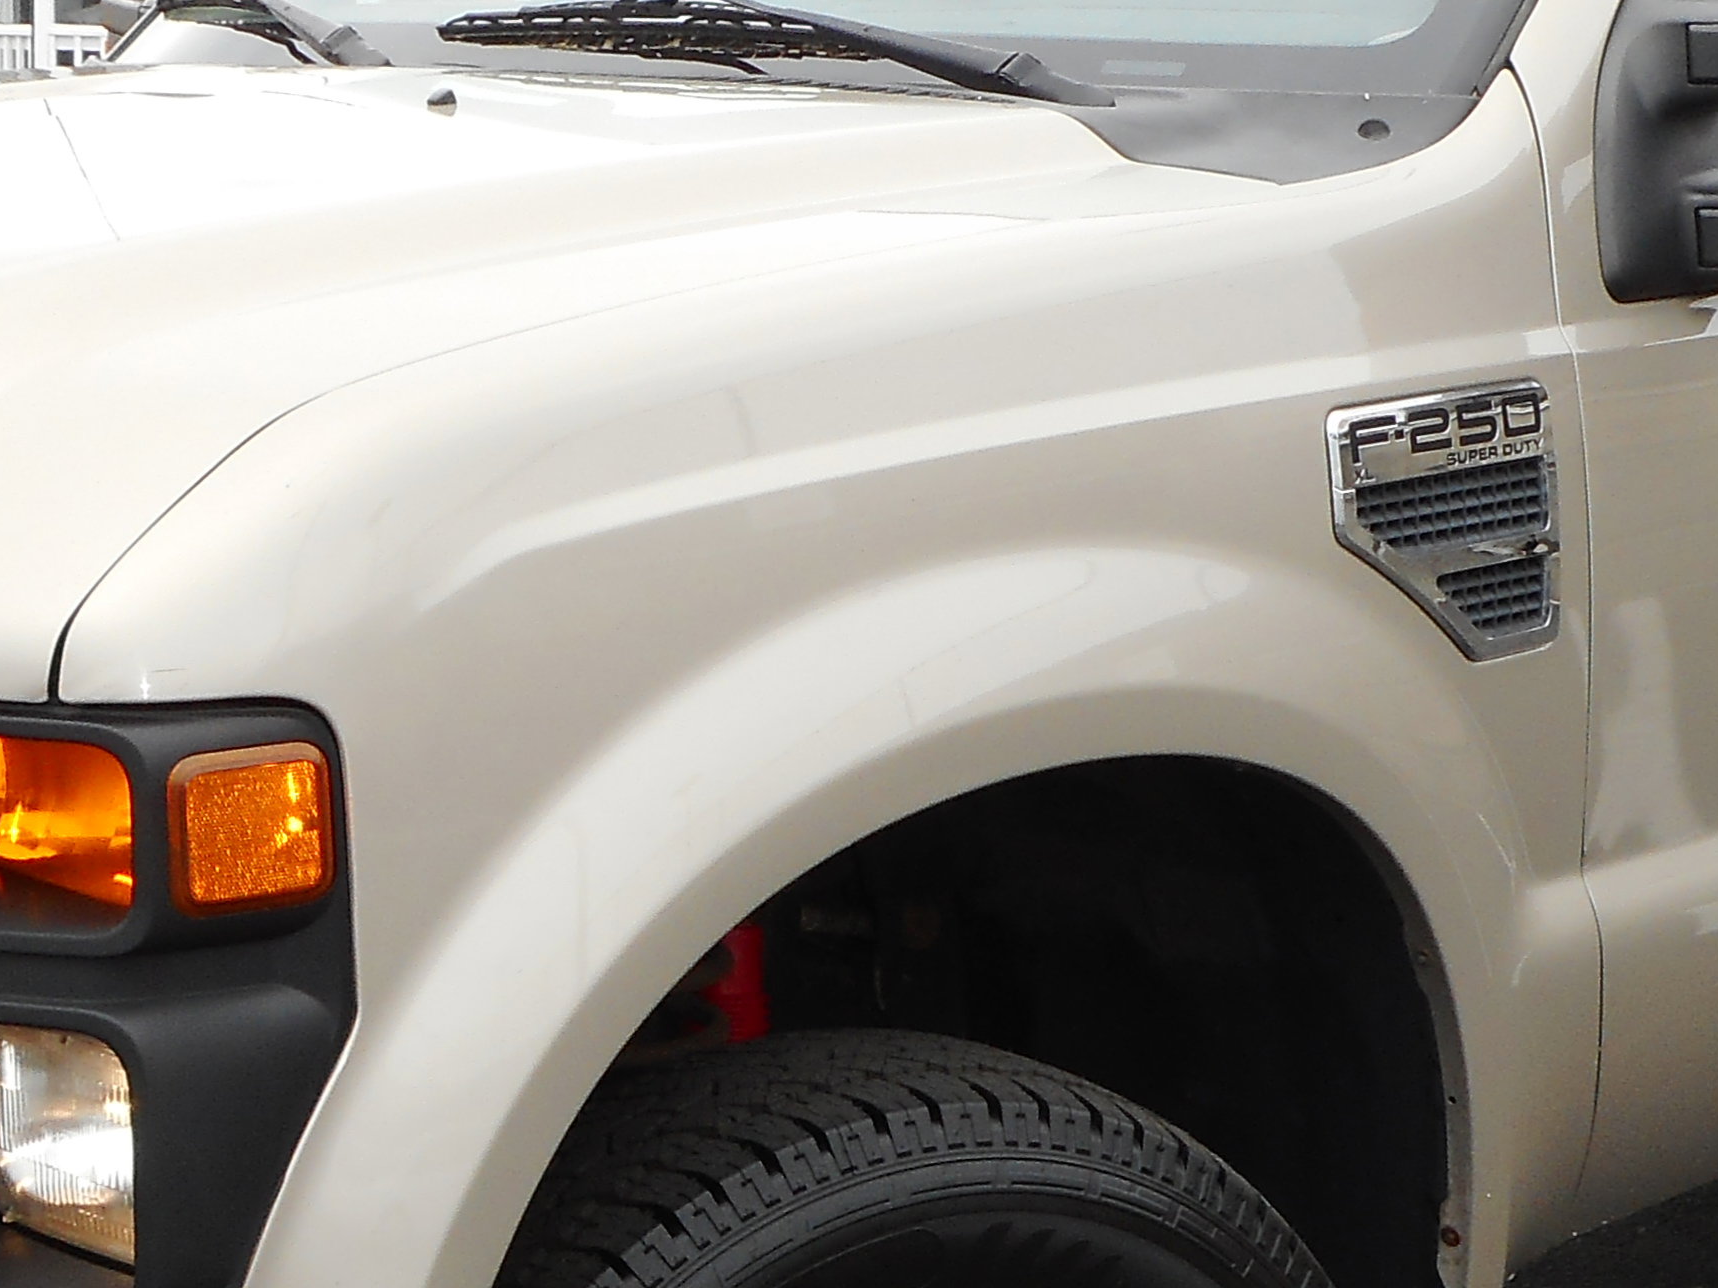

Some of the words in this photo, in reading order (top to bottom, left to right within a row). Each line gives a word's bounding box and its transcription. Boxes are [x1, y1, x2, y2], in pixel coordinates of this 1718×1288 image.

[1349, 392, 1543, 464] F-250
[1446, 446, 1499, 468] SUPER
[1502, 437, 1545, 458] DUTY
